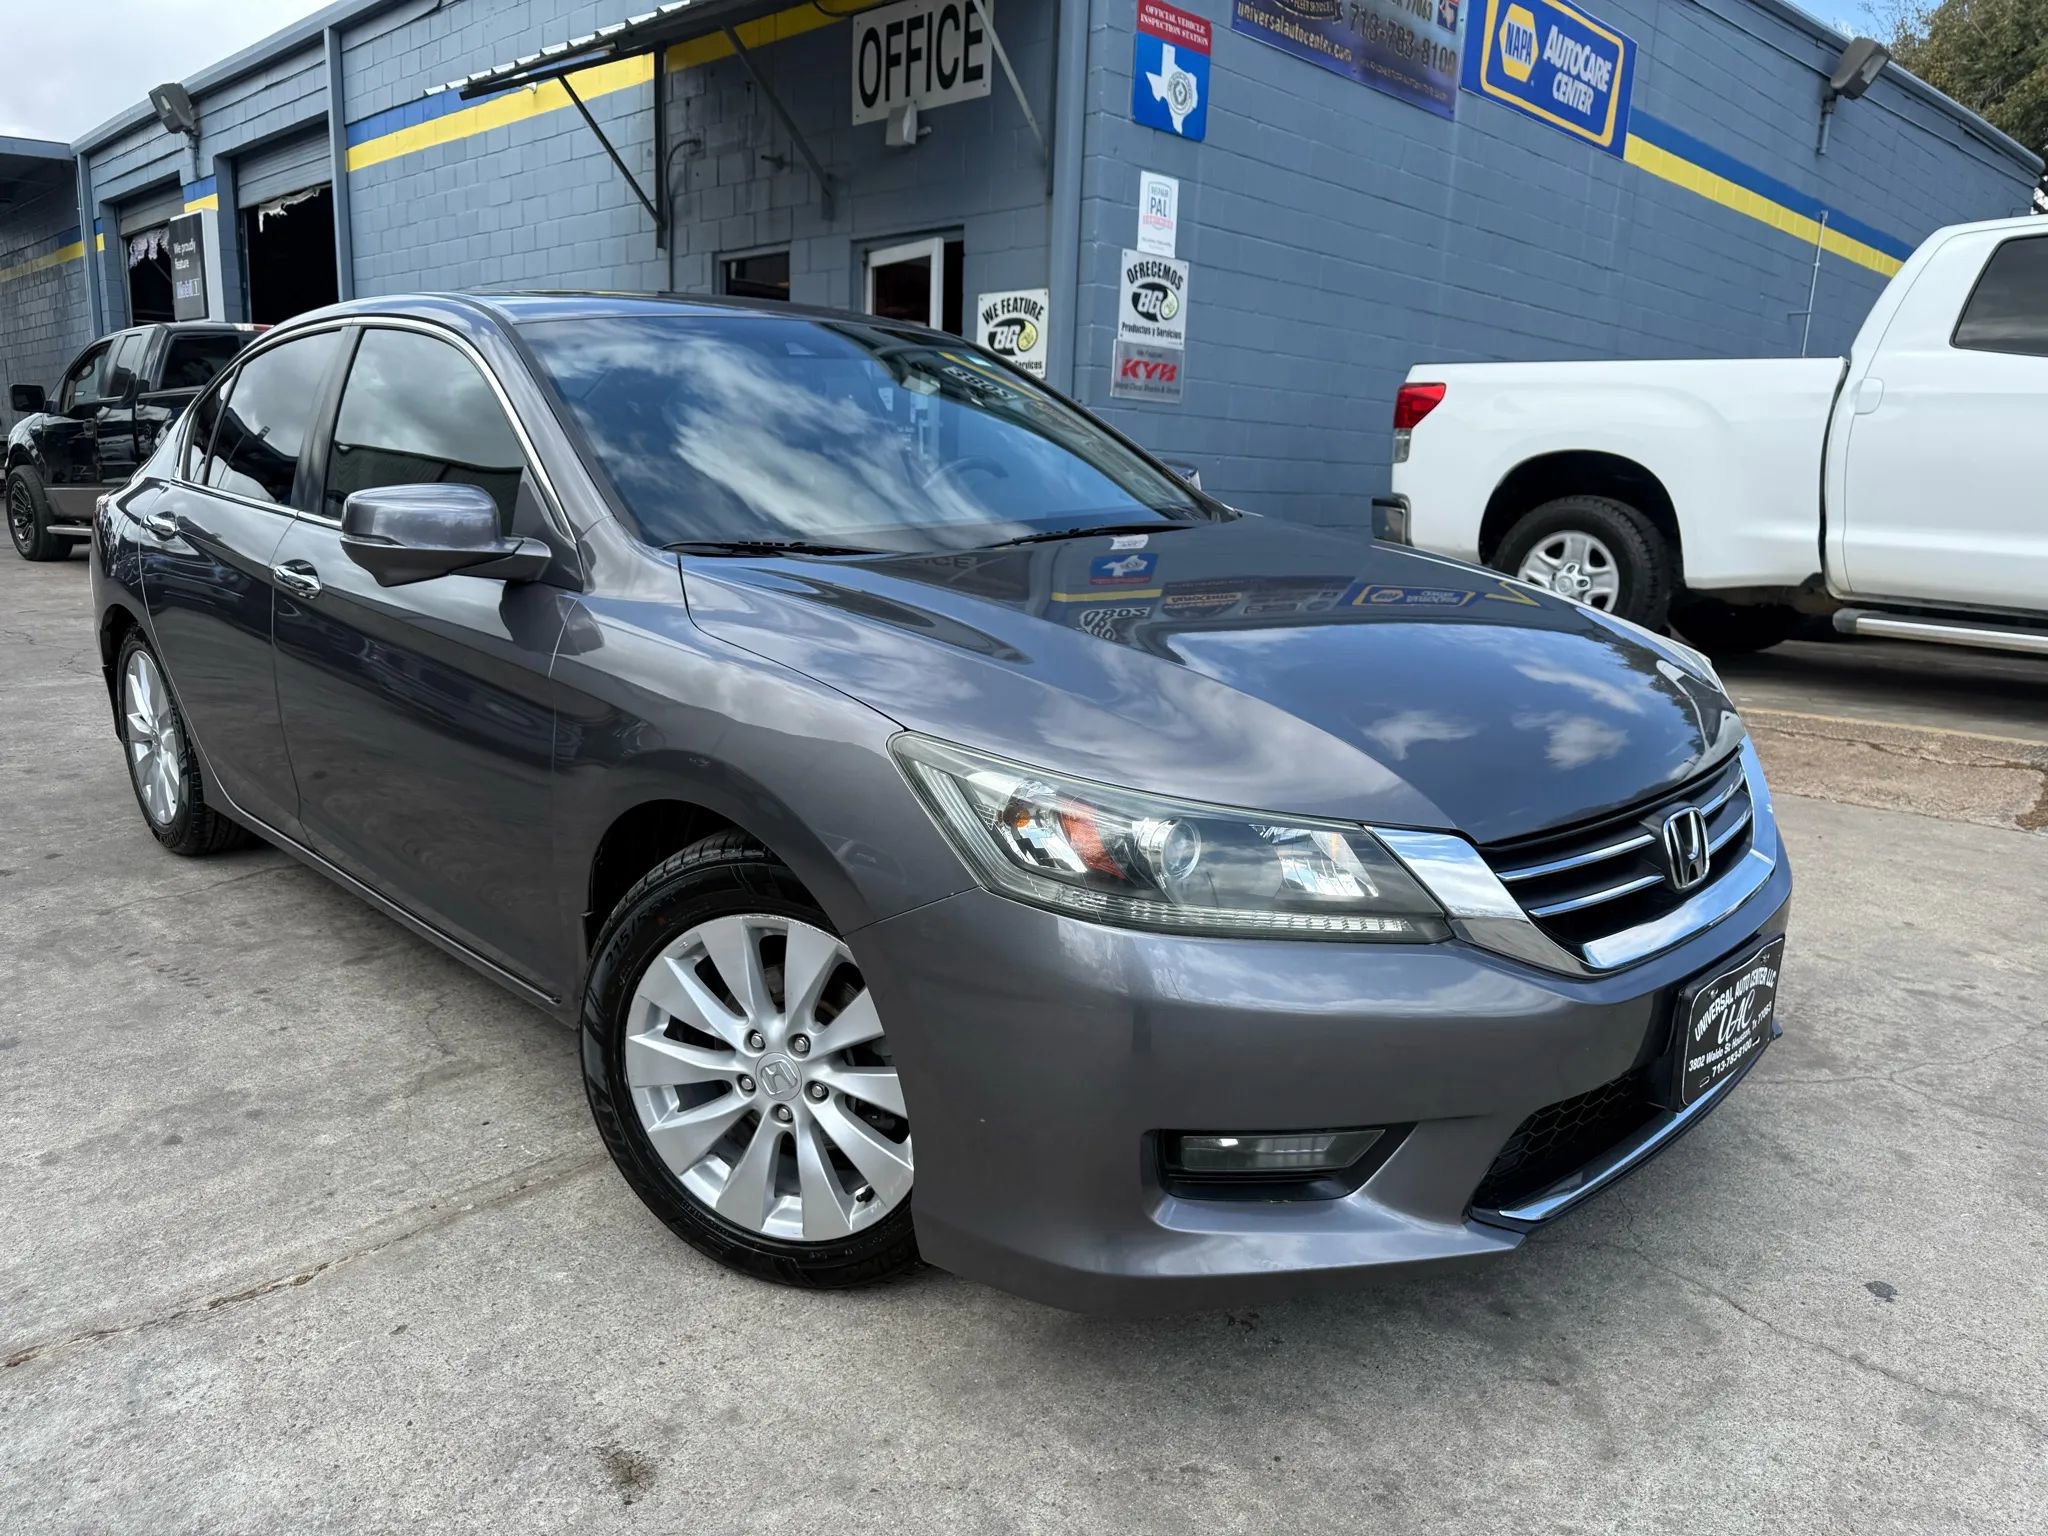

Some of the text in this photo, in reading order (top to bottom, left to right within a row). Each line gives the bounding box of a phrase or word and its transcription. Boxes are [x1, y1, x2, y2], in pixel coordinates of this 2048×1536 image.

[1140, 13, 1209, 47] INSPECTION STATION
[1145, 4, 1206, 35] OFFICIAL VEHICLE
[859, 0, 985, 108] OFFICE
[1504, 21, 1533, 65] NAPA
[1552, 71, 1595, 116] CENTER
[1150, 196, 1167, 218] PAL
[1126, 260, 1184, 291] OFRECEMOS
[982, 295, 1045, 325] WE FEATURE
[1136, 287, 1164, 315] BG
[993, 325, 1021, 350] BG
[1121, 321, 1151, 336] Productos
[1156, 327, 1183, 340] Servicios
[1015, 360, 1042, 370] ervices
[1121, 358, 1177, 382] KYB
[1694, 967, 1777, 1042] UNIVERSAL AUTO CENTER LLC
[1688, 1054, 1706, 1072] 3802
[1712, 1037, 1753, 1078] 713-783-8100
